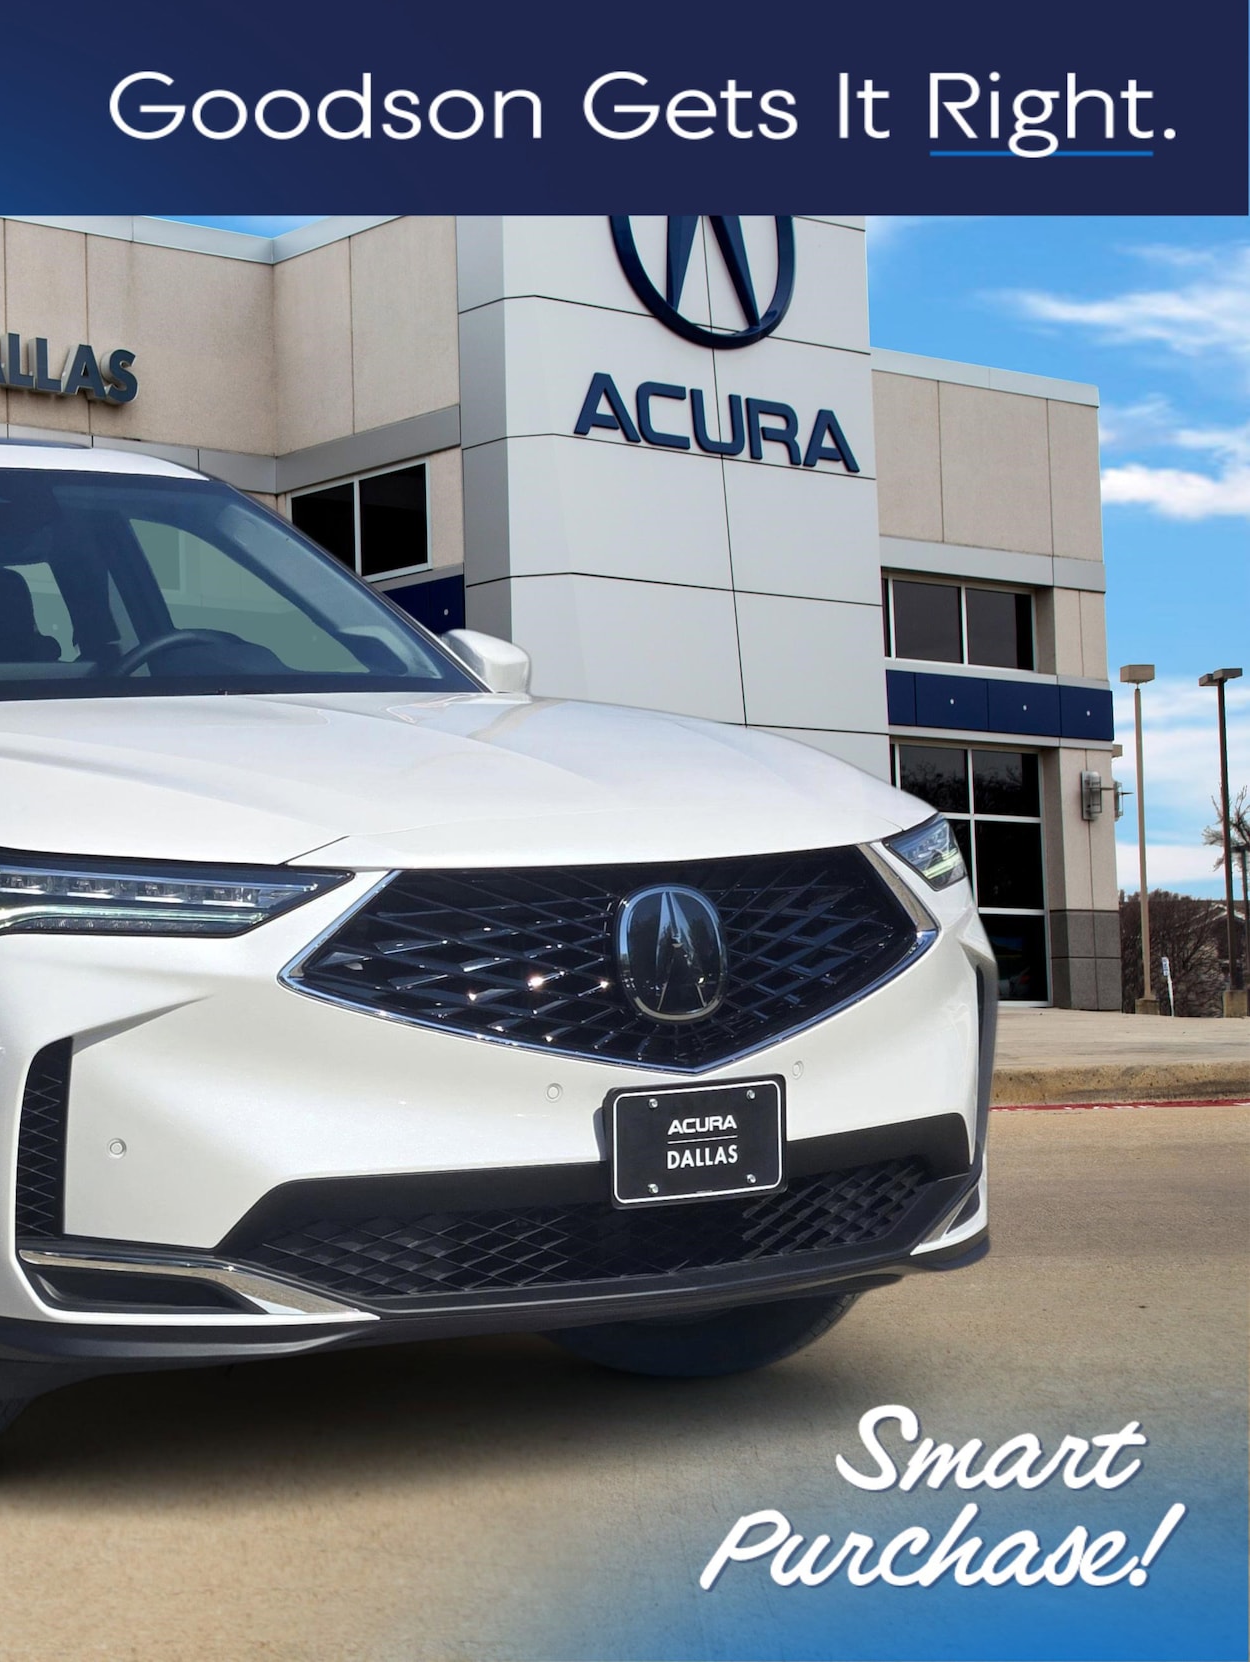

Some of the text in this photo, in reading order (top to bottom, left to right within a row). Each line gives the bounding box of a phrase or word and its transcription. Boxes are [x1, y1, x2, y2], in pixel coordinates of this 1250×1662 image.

[573, 371, 860, 473] ACURA
[667, 1114, 738, 1136] ACURA
[667, 1144, 738, 1170] DALLAS
